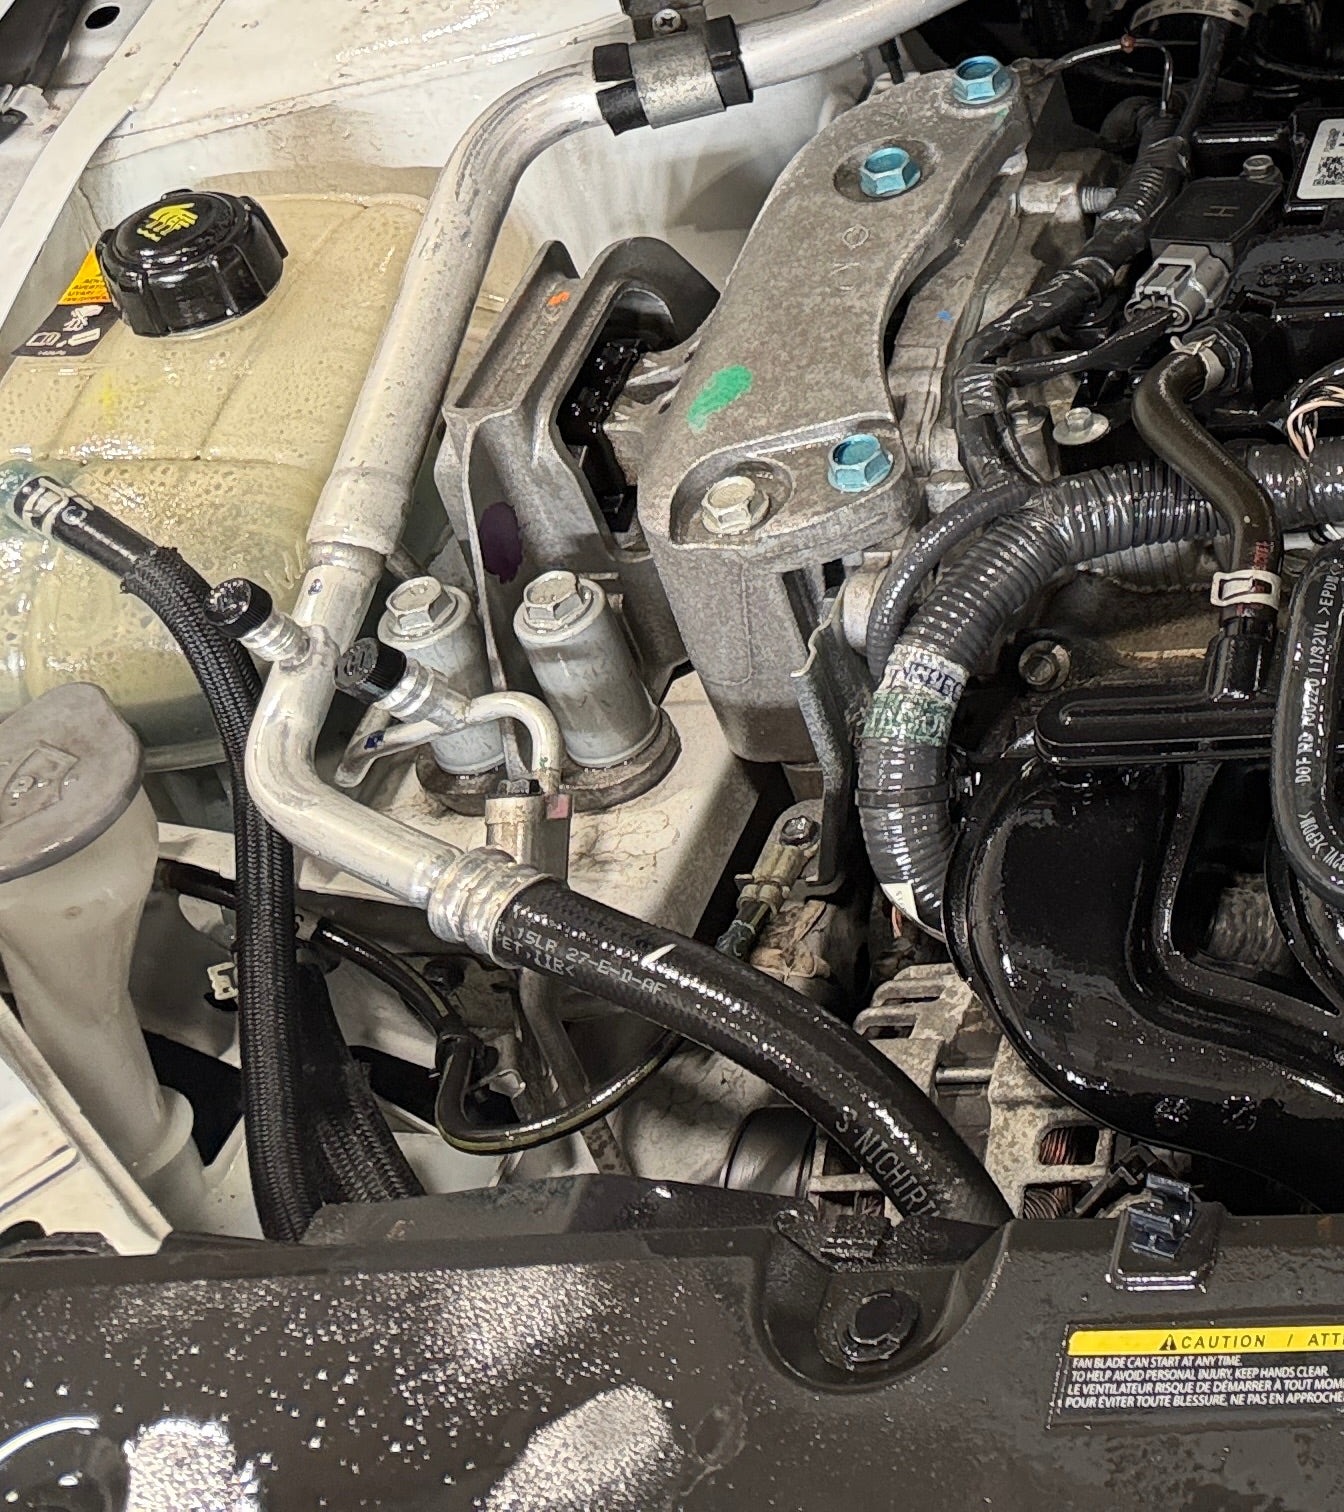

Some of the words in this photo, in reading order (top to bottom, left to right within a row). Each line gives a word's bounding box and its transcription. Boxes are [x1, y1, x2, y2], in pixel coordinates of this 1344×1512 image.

[1181, 1334, 1266, 1350] CAUTION
[1073, 1358, 1093, 1368] FAN
[1094, 1358, 1127, 1368] BLADE
[1127, 1358, 1148, 1367] CAN
[1150, 1357, 1180, 1367] START
[1182, 1357, 1195, 1366] AT
[1196, 1356, 1217, 1366] ANY
[1218, 1356, 1243, 1366] TIME.
[1072, 1370, 1085, 1382] TO
[1087, 1370, 1111, 1381] HELP
[1112, 1370, 1144, 1380] AVOID
[1145, 1369, 1196, 1380] PERSONAL
[1235, 1367, 1260, 1378] KEEP
[1261, 1367, 1296, 1378] HANDS
[1068, 1384, 1079, 1395] LE
[1081, 1383, 1153, 1394] VENTILATEUR
[1155, 1382, 1195, 1394] RISQUE
[1197, 1382, 1211, 1392] DE
[1213, 1377, 1272, 1392] DÉMARRER
[1283, 1379, 1312, 1390] TOUT
[1065, 1397, 1097, 1409] POUR
[1136, 1396, 1171, 1407] TOUTE
[1230, 1394, 1245, 1406] NE
[1247, 1394, 1267, 1405] PAS
[1269, 1394, 1283, 1404] EN
